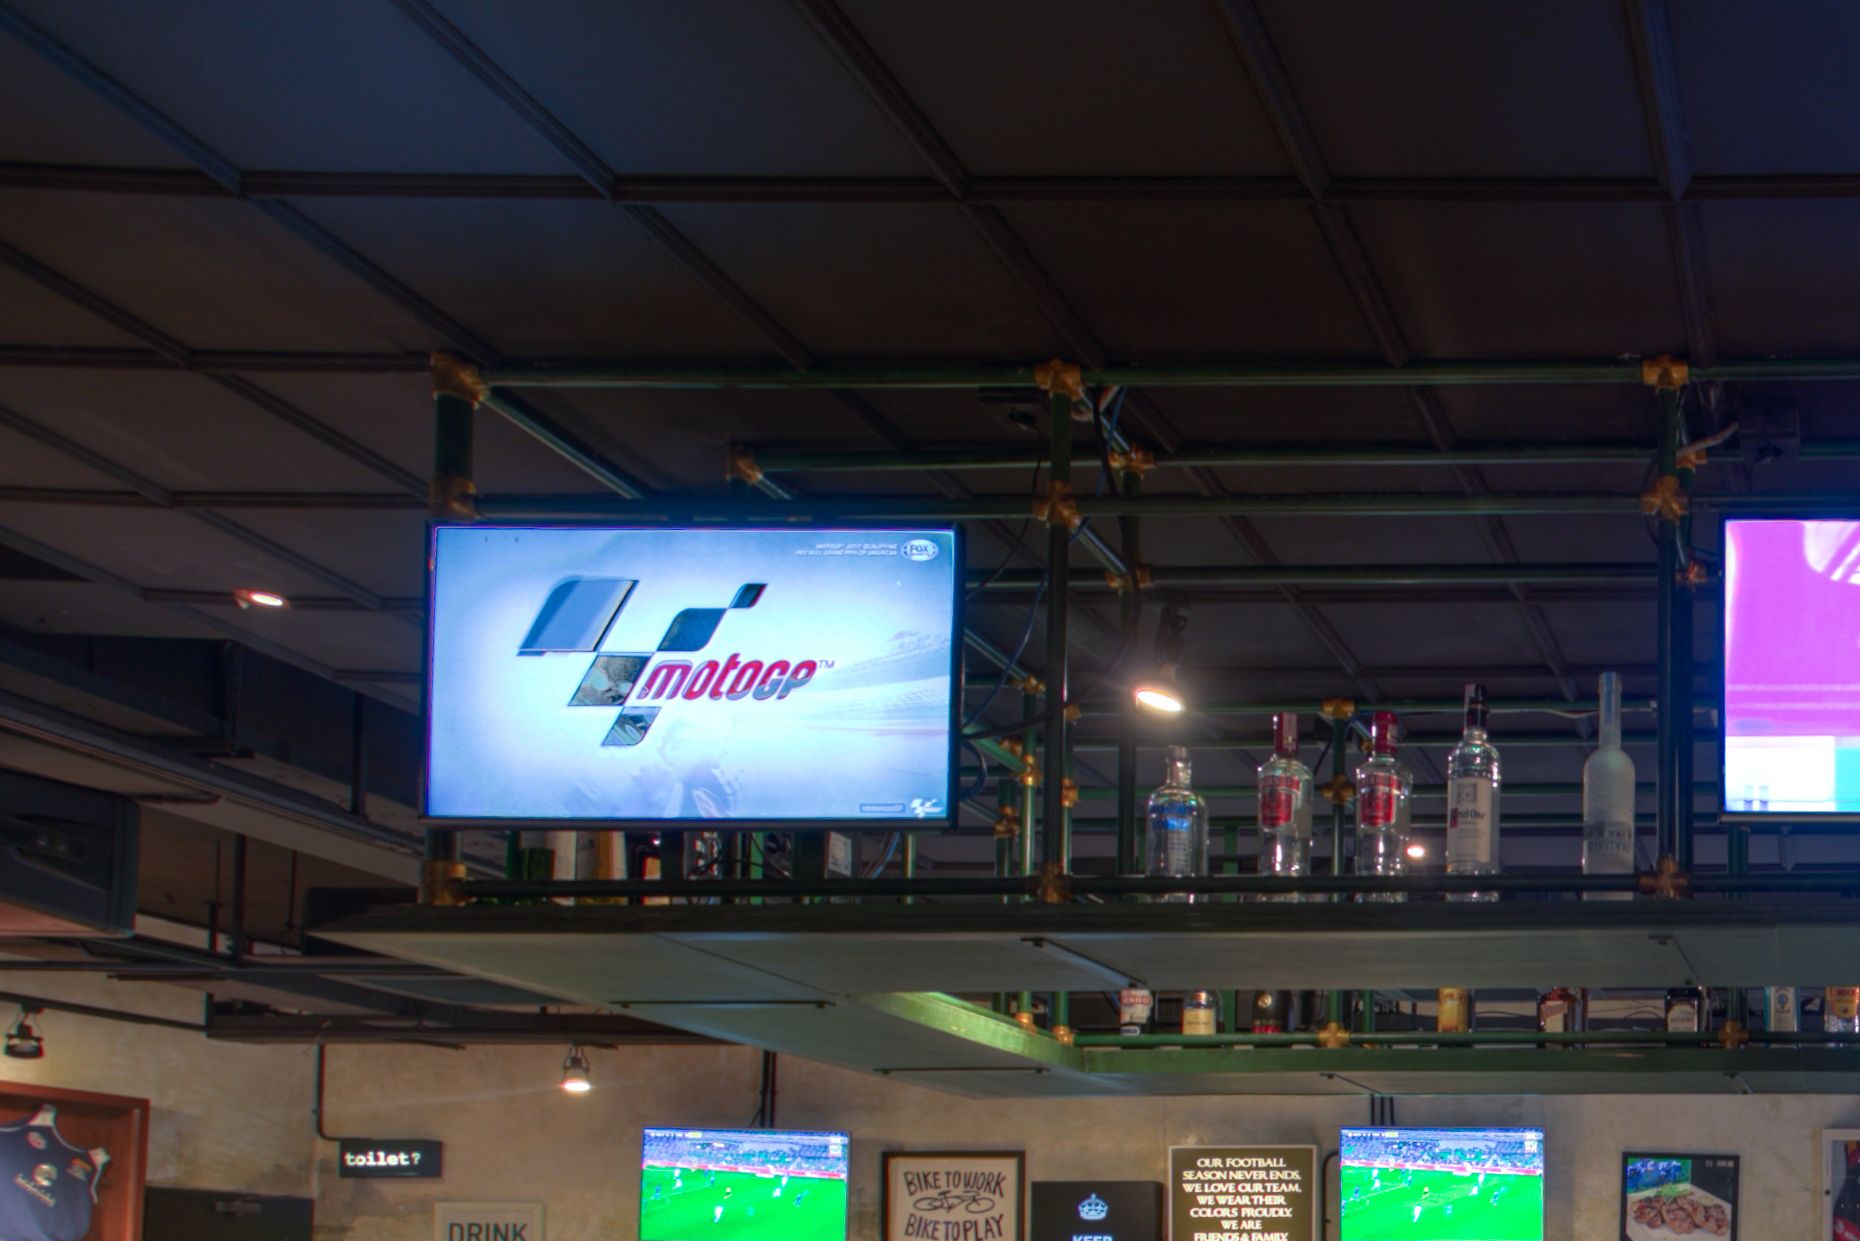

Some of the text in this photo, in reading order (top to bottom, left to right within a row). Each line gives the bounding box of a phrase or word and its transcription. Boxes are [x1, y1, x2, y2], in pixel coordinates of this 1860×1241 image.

[344, 1150, 421, 1166] toilet?
[1197, 1158, 1286, 1167] OUR FOOTBALL
[1182, 1170, 1227, 1180] SEASON
[1228, 1170, 1268, 1180] NEVER
[904, 1171, 1007, 1198] BIKE TO WORK
[1182, 1183, 1302, 1193] WE LOVE OUR TEAM.
[1197, 1195, 1287, 1205] WE WEAR THEIR
[1190, 1208, 1238, 1217] COLORS
[904, 1213, 1004, 1241] BIKE TO PLAY
[1221, 1220, 1262, 1229] WE ARE
[1194, 1233, 1239, 1241] FRIENDS
[1240, 1233, 1250, 1241] &
